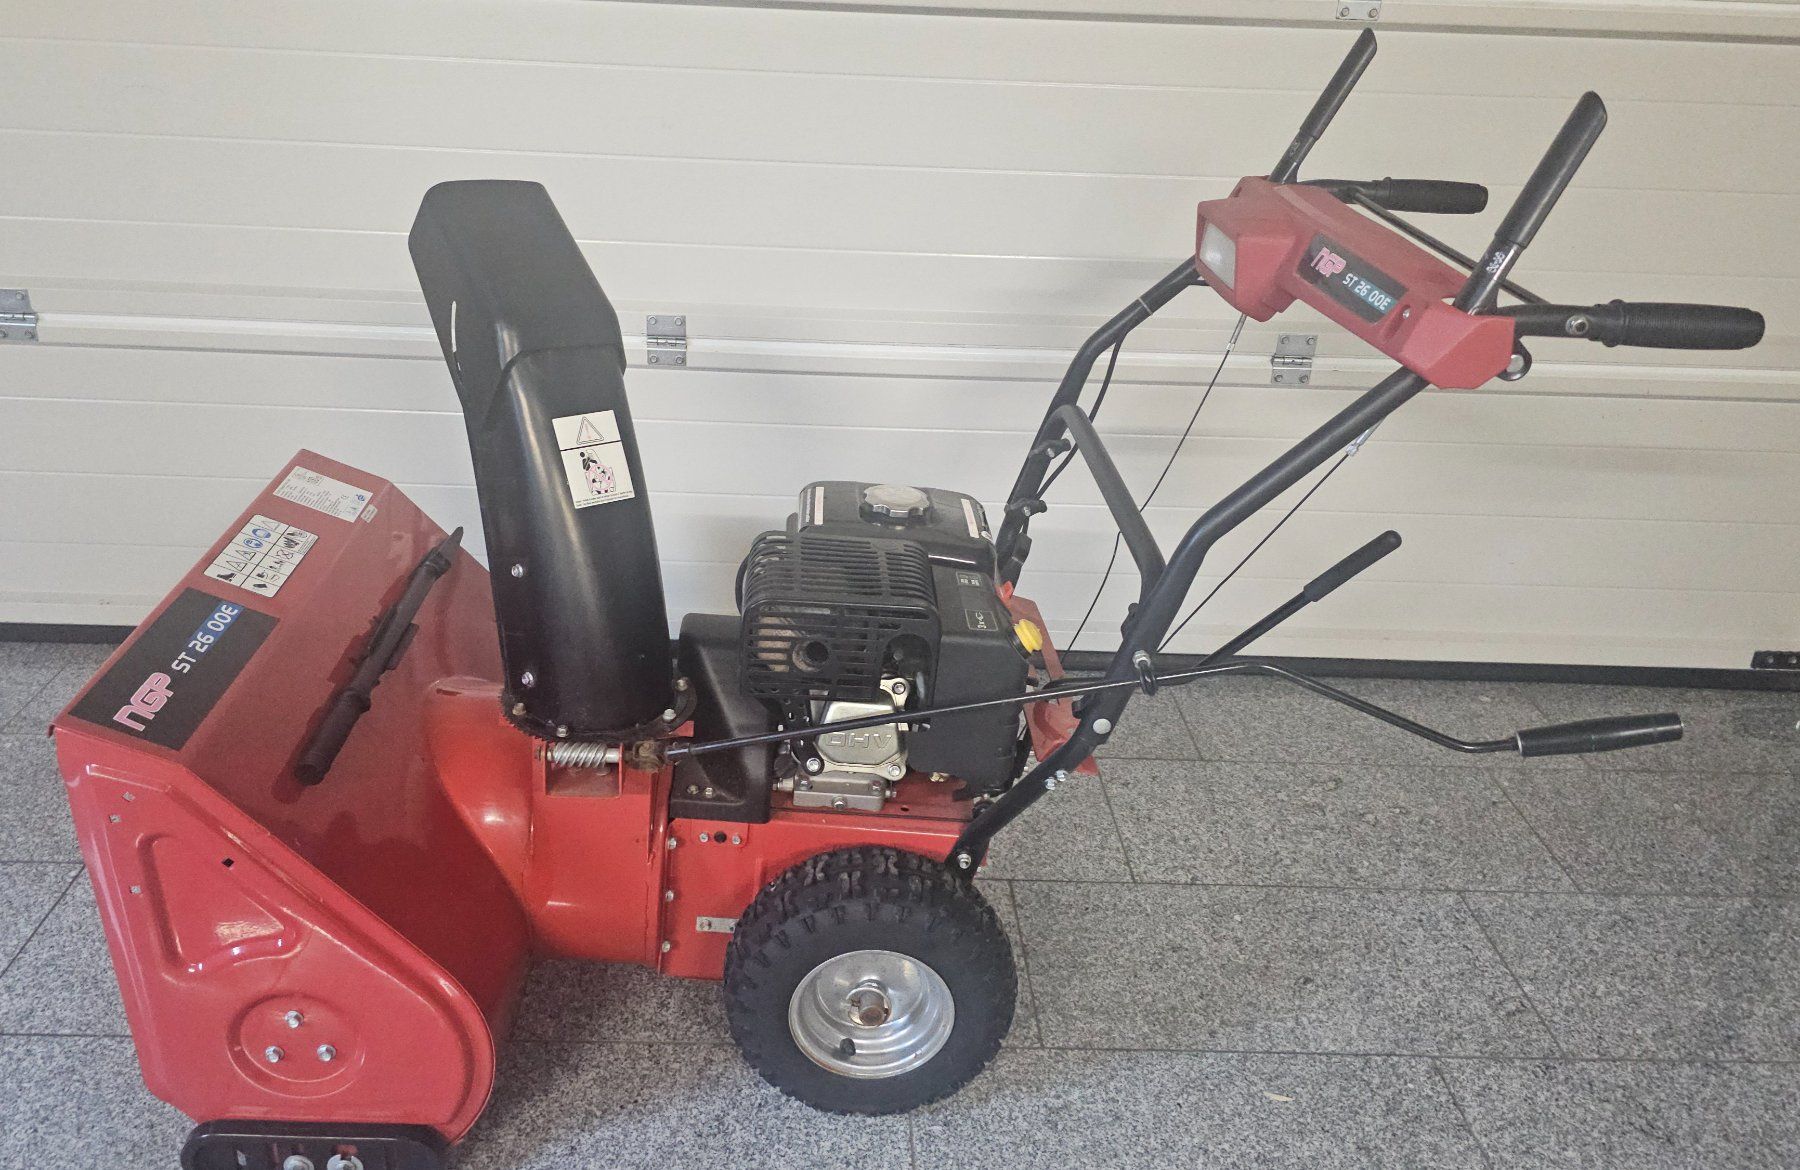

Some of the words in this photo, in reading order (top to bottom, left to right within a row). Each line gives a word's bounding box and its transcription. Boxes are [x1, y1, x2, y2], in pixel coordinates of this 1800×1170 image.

[1310, 247, 1346, 277] NGP
[1342, 273, 1359, 287] ST
[1354, 280, 1371, 297] 26
[171, 652, 196, 674] ST
[188, 631, 215, 653] 26
[112, 672, 174, 732] NGP
[825, 731, 893, 749] OHV
